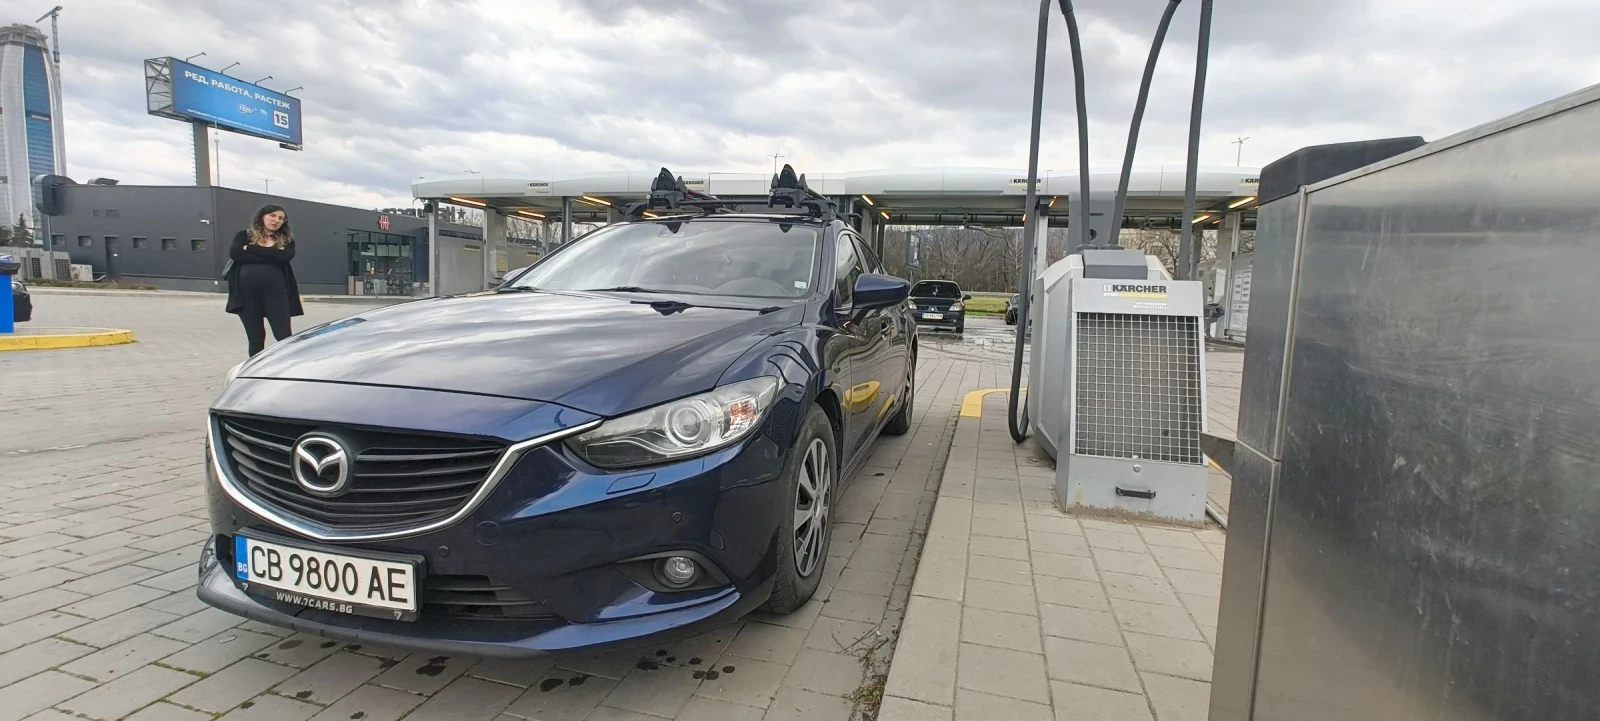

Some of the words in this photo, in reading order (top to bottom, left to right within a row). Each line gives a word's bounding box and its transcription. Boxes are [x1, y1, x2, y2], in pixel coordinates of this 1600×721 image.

[185, 70, 209, 85] РЕД,
[212, 80, 253, 98] РАБОТА,
[254, 93, 291, 109] РАСТЕЖ
[275, 113, 288, 126] 15
[1112, 284, 1167, 294] KÄRCHER
[237, 562, 248, 574] BG
[251, 545, 283, 582] CB
[289, 553, 359, 596] 9800
[367, 565, 408, 604] AE
[276, 591, 353, 614] WWW.7CARS.BG
